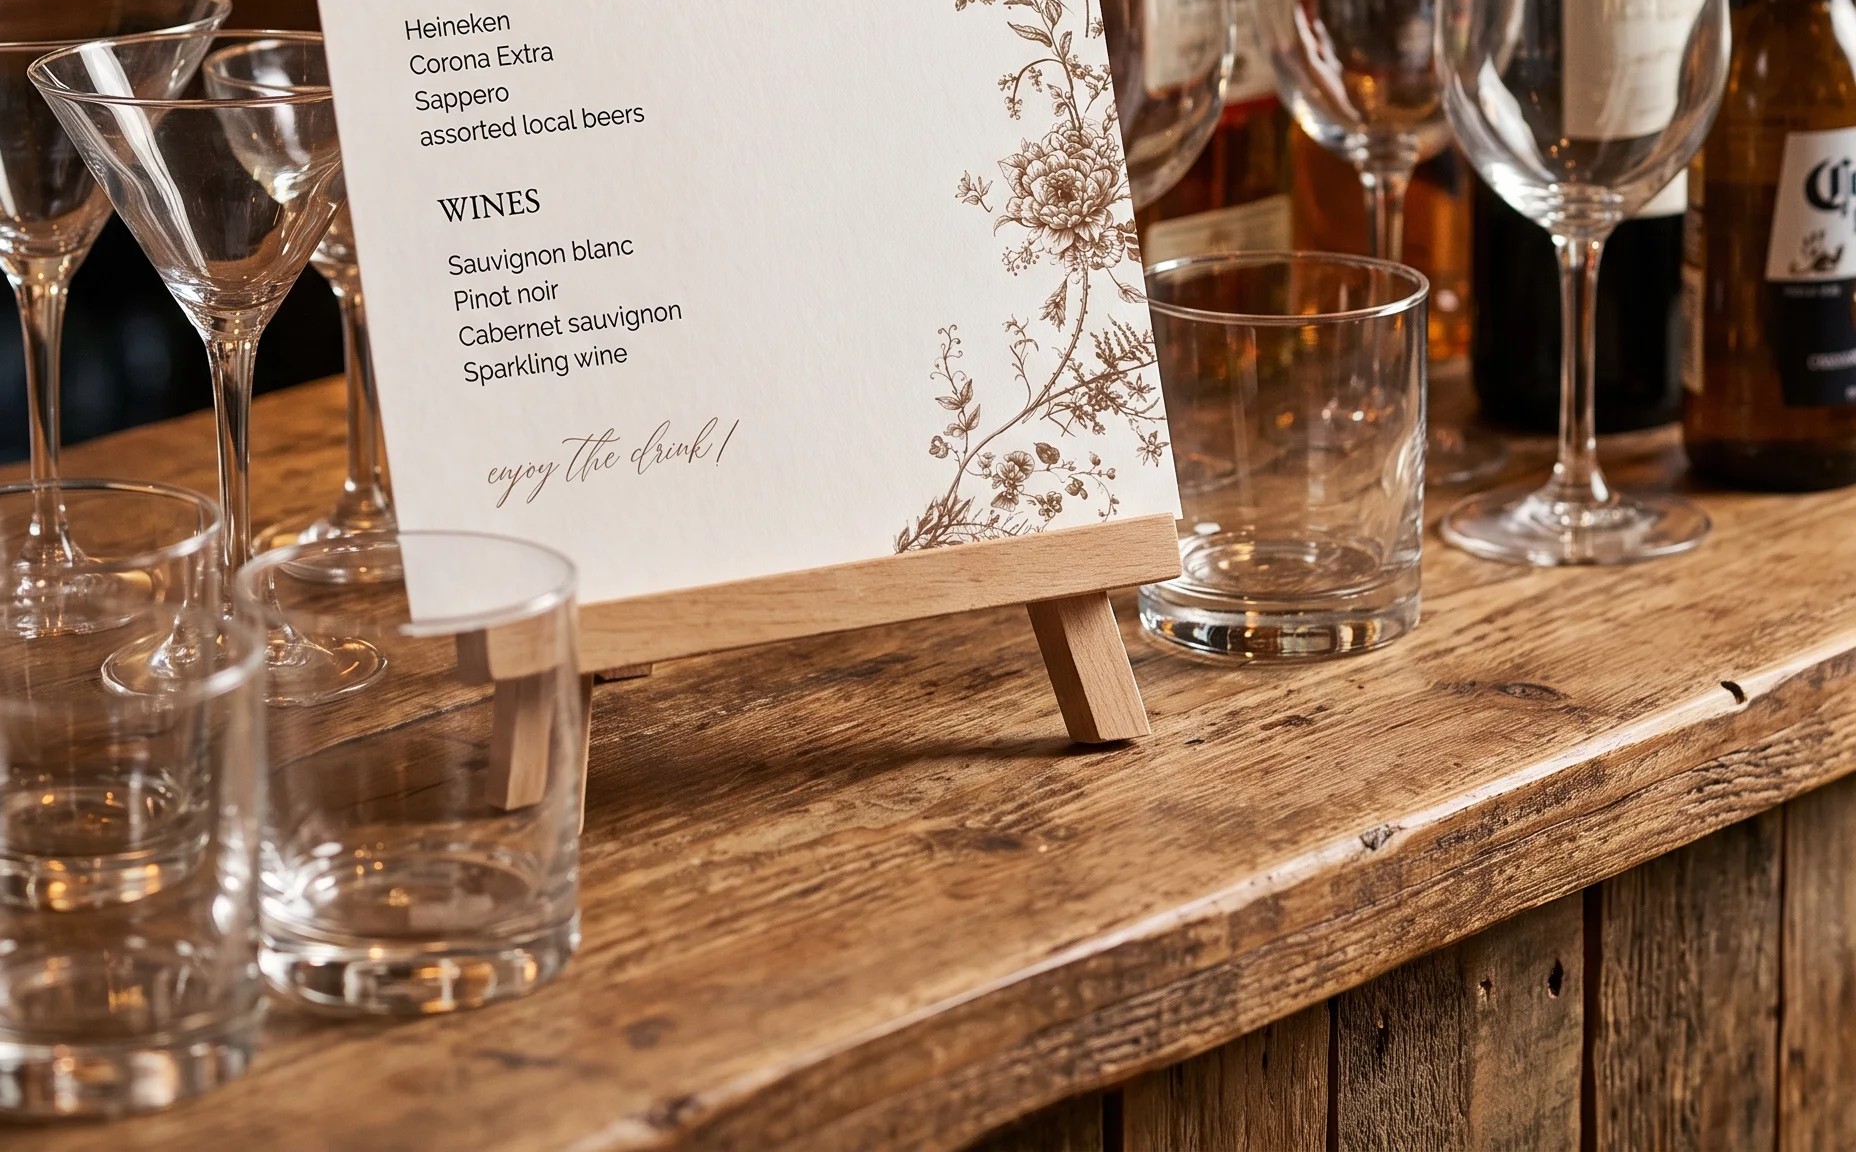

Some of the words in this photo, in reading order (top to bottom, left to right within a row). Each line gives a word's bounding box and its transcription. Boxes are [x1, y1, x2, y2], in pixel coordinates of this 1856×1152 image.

[404, 12, 511, 41] Heineken
[409, 51, 491, 76] Corona
[496, 43, 555, 67] Extra
[414, 85, 510, 114] Sappero
[420, 115, 518, 147] assorted
[521, 108, 578, 136] local
[581, 106, 645, 129] beers
[436, 188, 541, 223] WINES
[448, 247, 567, 276] Sauvignon
[571, 238, 634, 262] blanc
[453, 285, 513, 312] Pinot
[517, 279, 559, 305] noir
[458, 314, 564, 347] Cabernet
[567, 303, 682, 334] sauvignon
[463, 354, 570, 387] Sparkling
[573, 347, 628, 369] wine
[487, 461, 560, 509] enjoy
